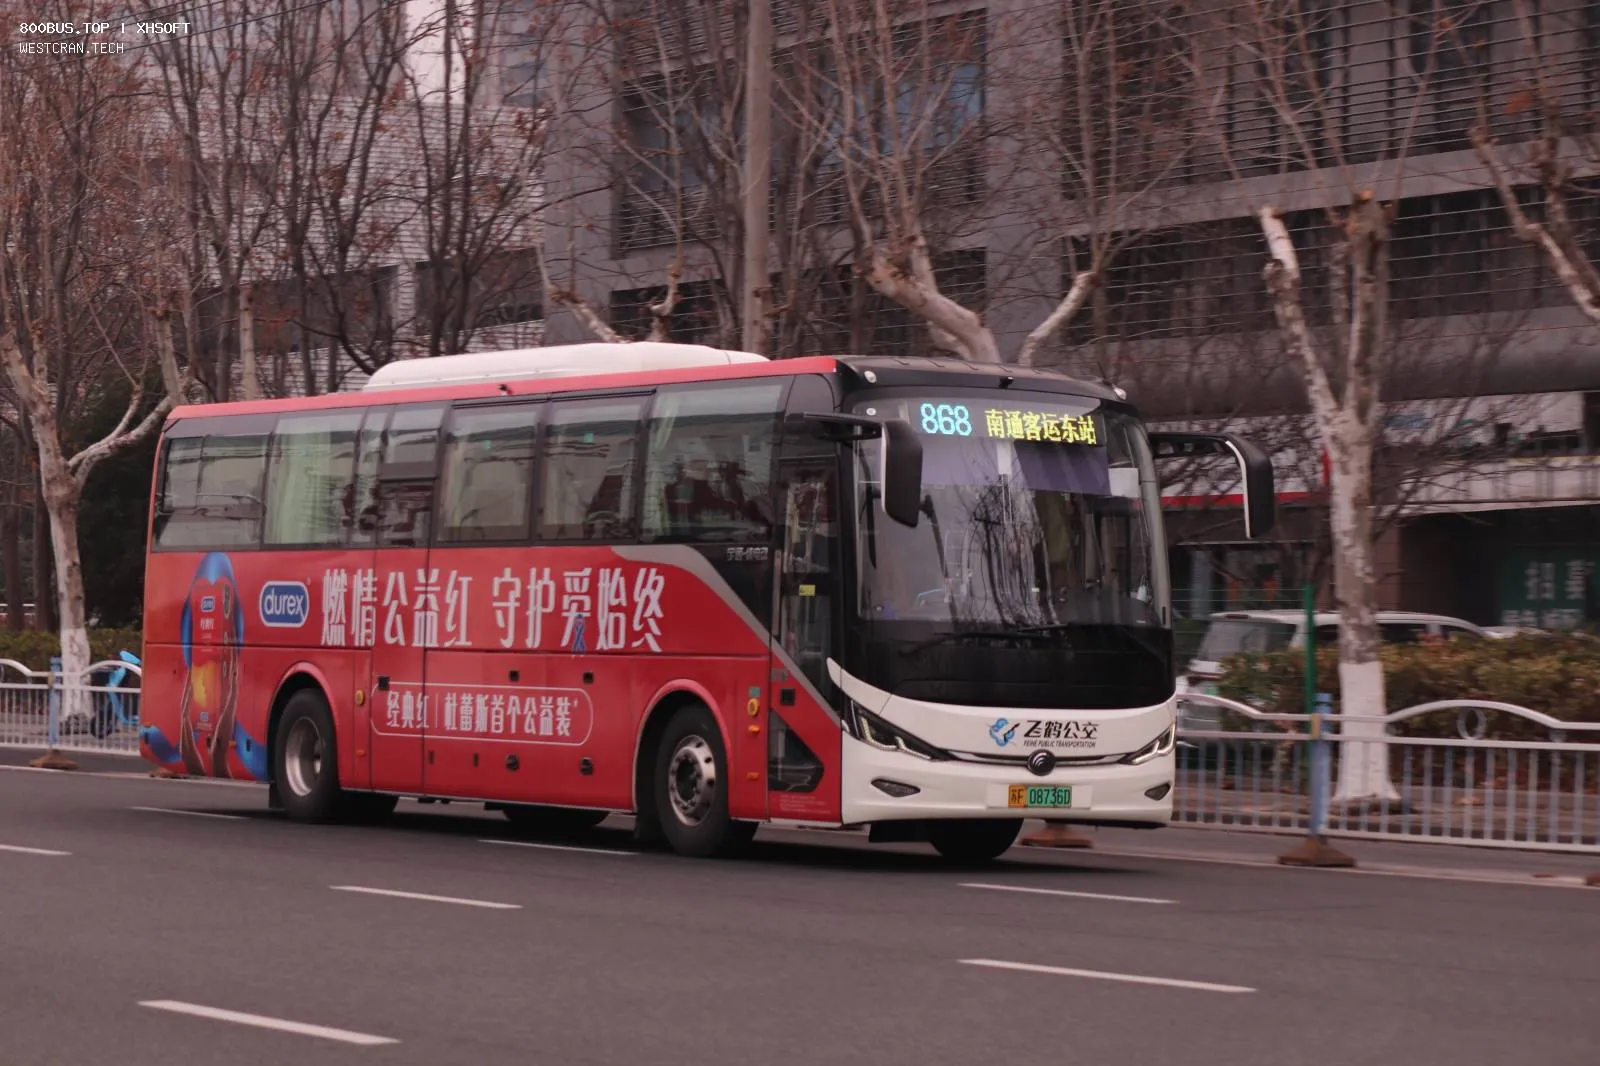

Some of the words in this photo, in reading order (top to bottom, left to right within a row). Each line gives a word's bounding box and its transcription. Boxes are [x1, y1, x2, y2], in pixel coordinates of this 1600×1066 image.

[920, 403, 972, 437] 868
[984, 408, 1097, 445] 南通客运东站
[263, 587, 306, 621] durex
[320, 568, 473, 647] 燃情公益红
[492, 567, 665, 655] 守护爱始终
[386, 690, 429, 728] 经典红
[444, 692, 571, 737] 杜蕾斯首个公益装
[1023, 719, 1099, 739] 飞鹤公交
[1038, 740, 1055, 748] PUBLIC
[1056, 740, 1096, 749] TRANSPORTATION
[1029, 788, 1071, 805] 08736D
